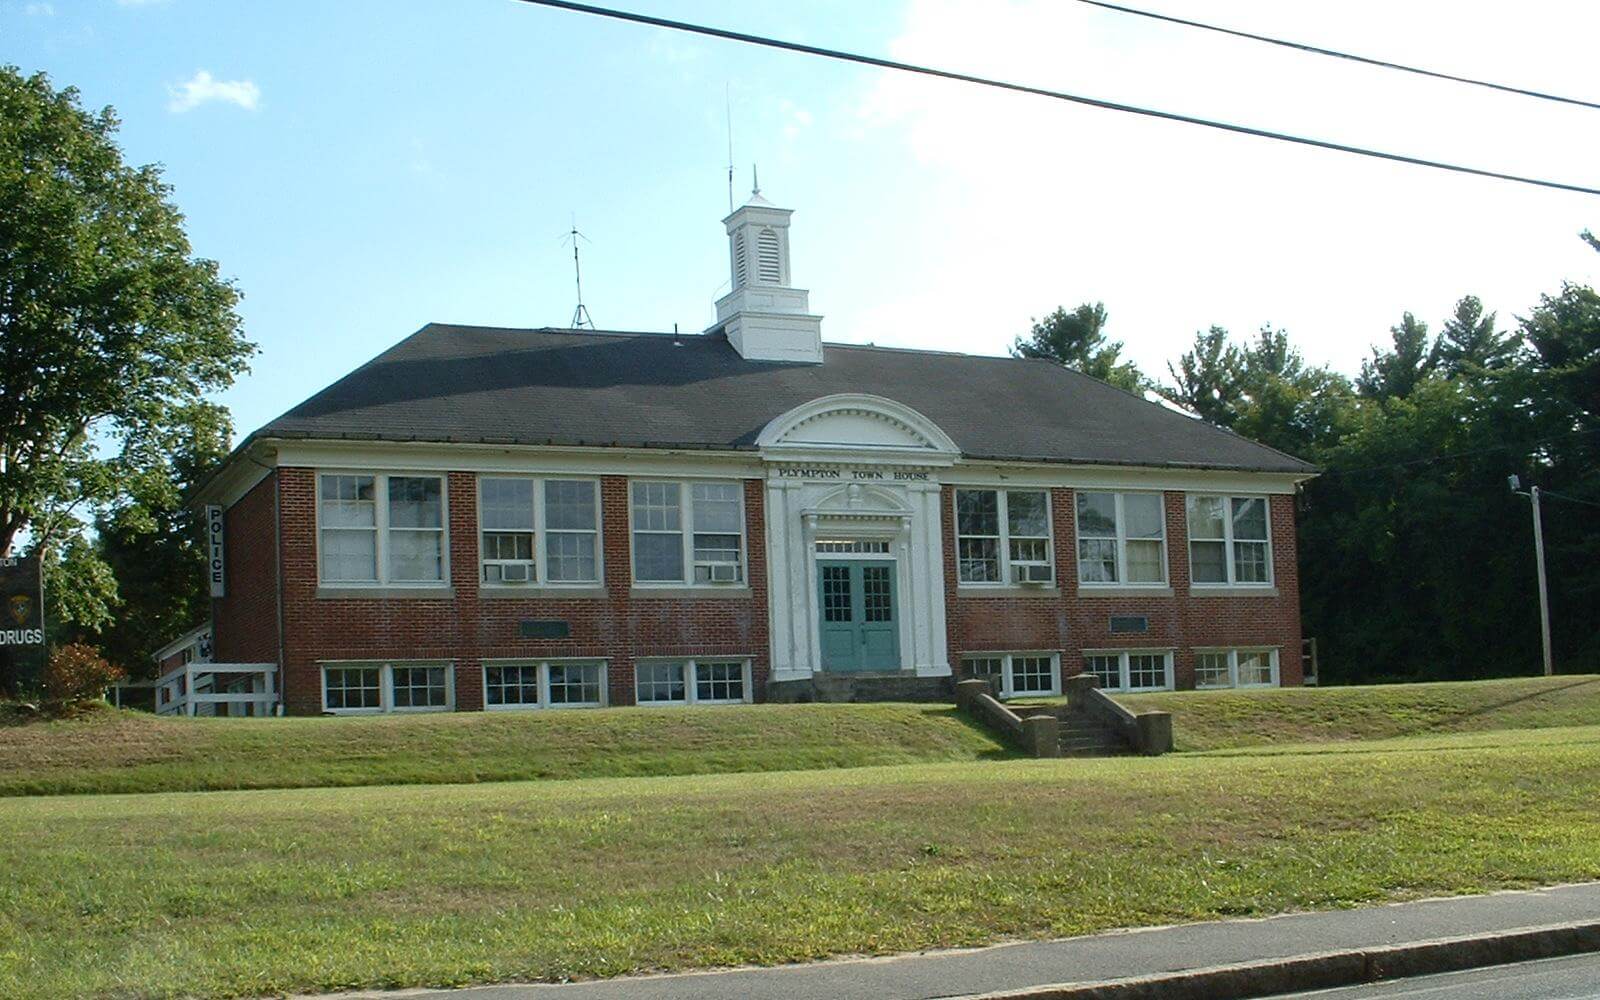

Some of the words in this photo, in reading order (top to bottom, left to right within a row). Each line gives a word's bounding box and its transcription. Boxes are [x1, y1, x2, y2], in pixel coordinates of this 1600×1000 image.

[778, 468, 840, 479] PLYMPTON
[852, 470, 884, 480] TOWN
[893, 471, 929, 481] HOUSE
[211, 510, 222, 583] POLICE
[0, 629, 42, 645] DRUGS
